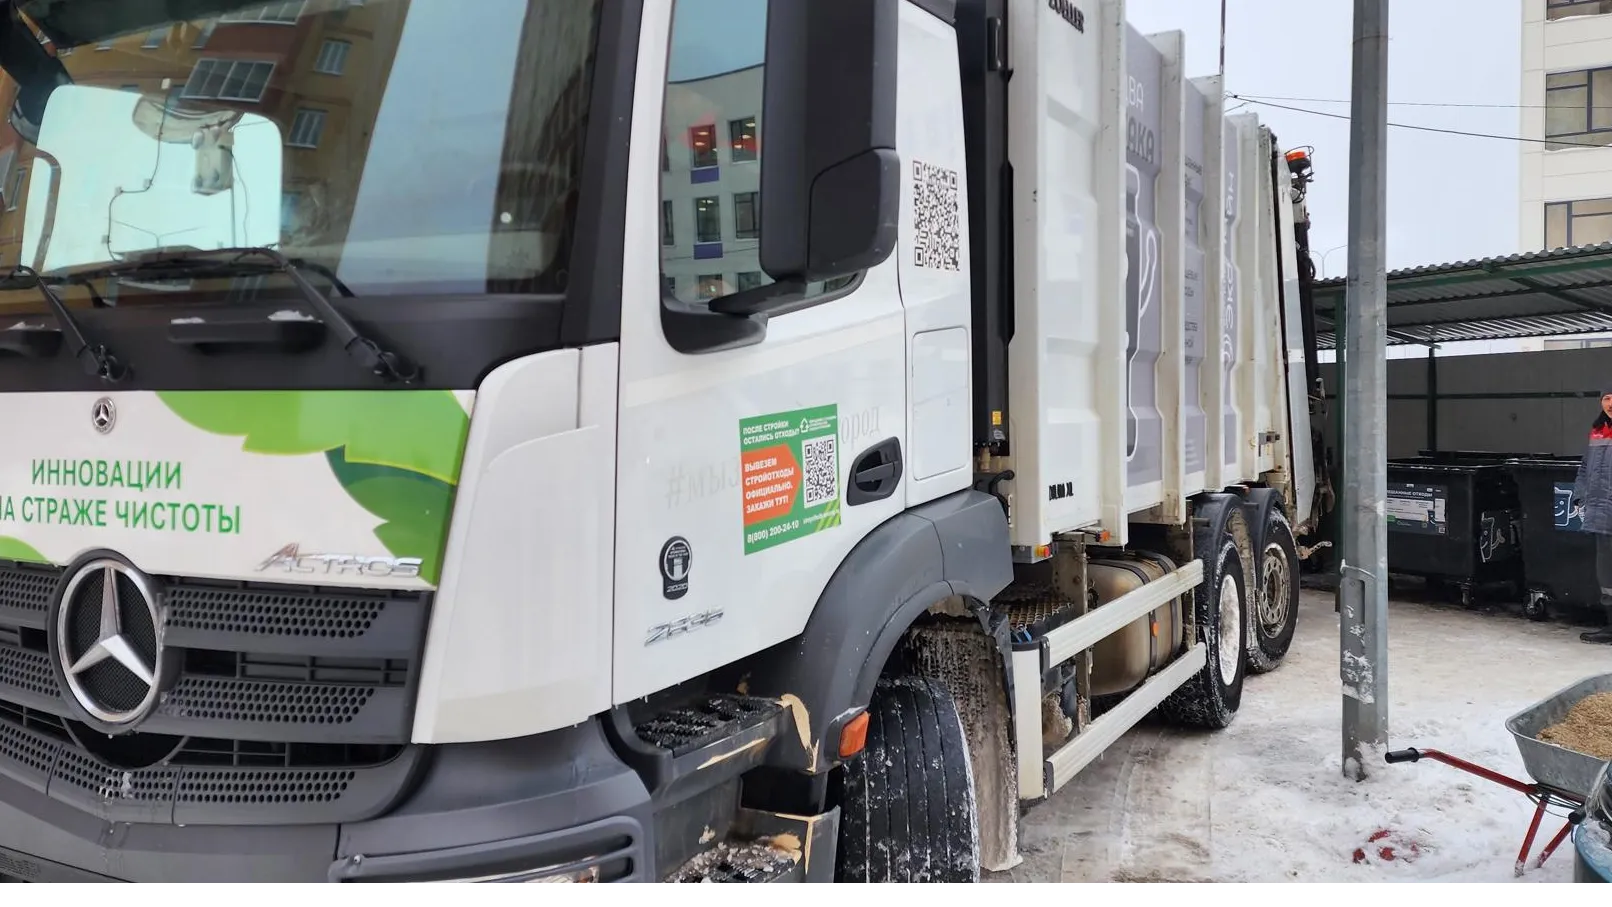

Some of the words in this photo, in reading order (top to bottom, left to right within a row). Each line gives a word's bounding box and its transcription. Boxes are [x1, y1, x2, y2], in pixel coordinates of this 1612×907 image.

[1126, 76, 1144, 112] ВА
[1127, 116, 1155, 164] АКА
[743, 425, 763, 436] ПОСЛЕ
[763, 420, 789, 432] СТРОЙКИ
[743, 434, 774, 445] ОСТАЛИСЬ
[745, 457, 777, 472] ВЫВЕЗЕМ
[32, 459, 181, 492] ИННОВАЦИИ
[745, 466, 794, 486] СТРОЙОТХОДЫ
[746, 481, 793, 500] ОФИЦИАЛЬНО.
[746, 499, 774, 513] ЗАКАЖИ
[775, 495, 789, 506] ТУТ!
[22, 496, 107, 526] СТРАЖЕ
[115, 500, 240, 534] ЧИСТОТЫ
[747, 530, 769, 544] 8(800)
[769, 520, 799, 534] 200-24-10
[254, 543, 423, 578] ACTROS
[667, 582, 689, 592] 2020
